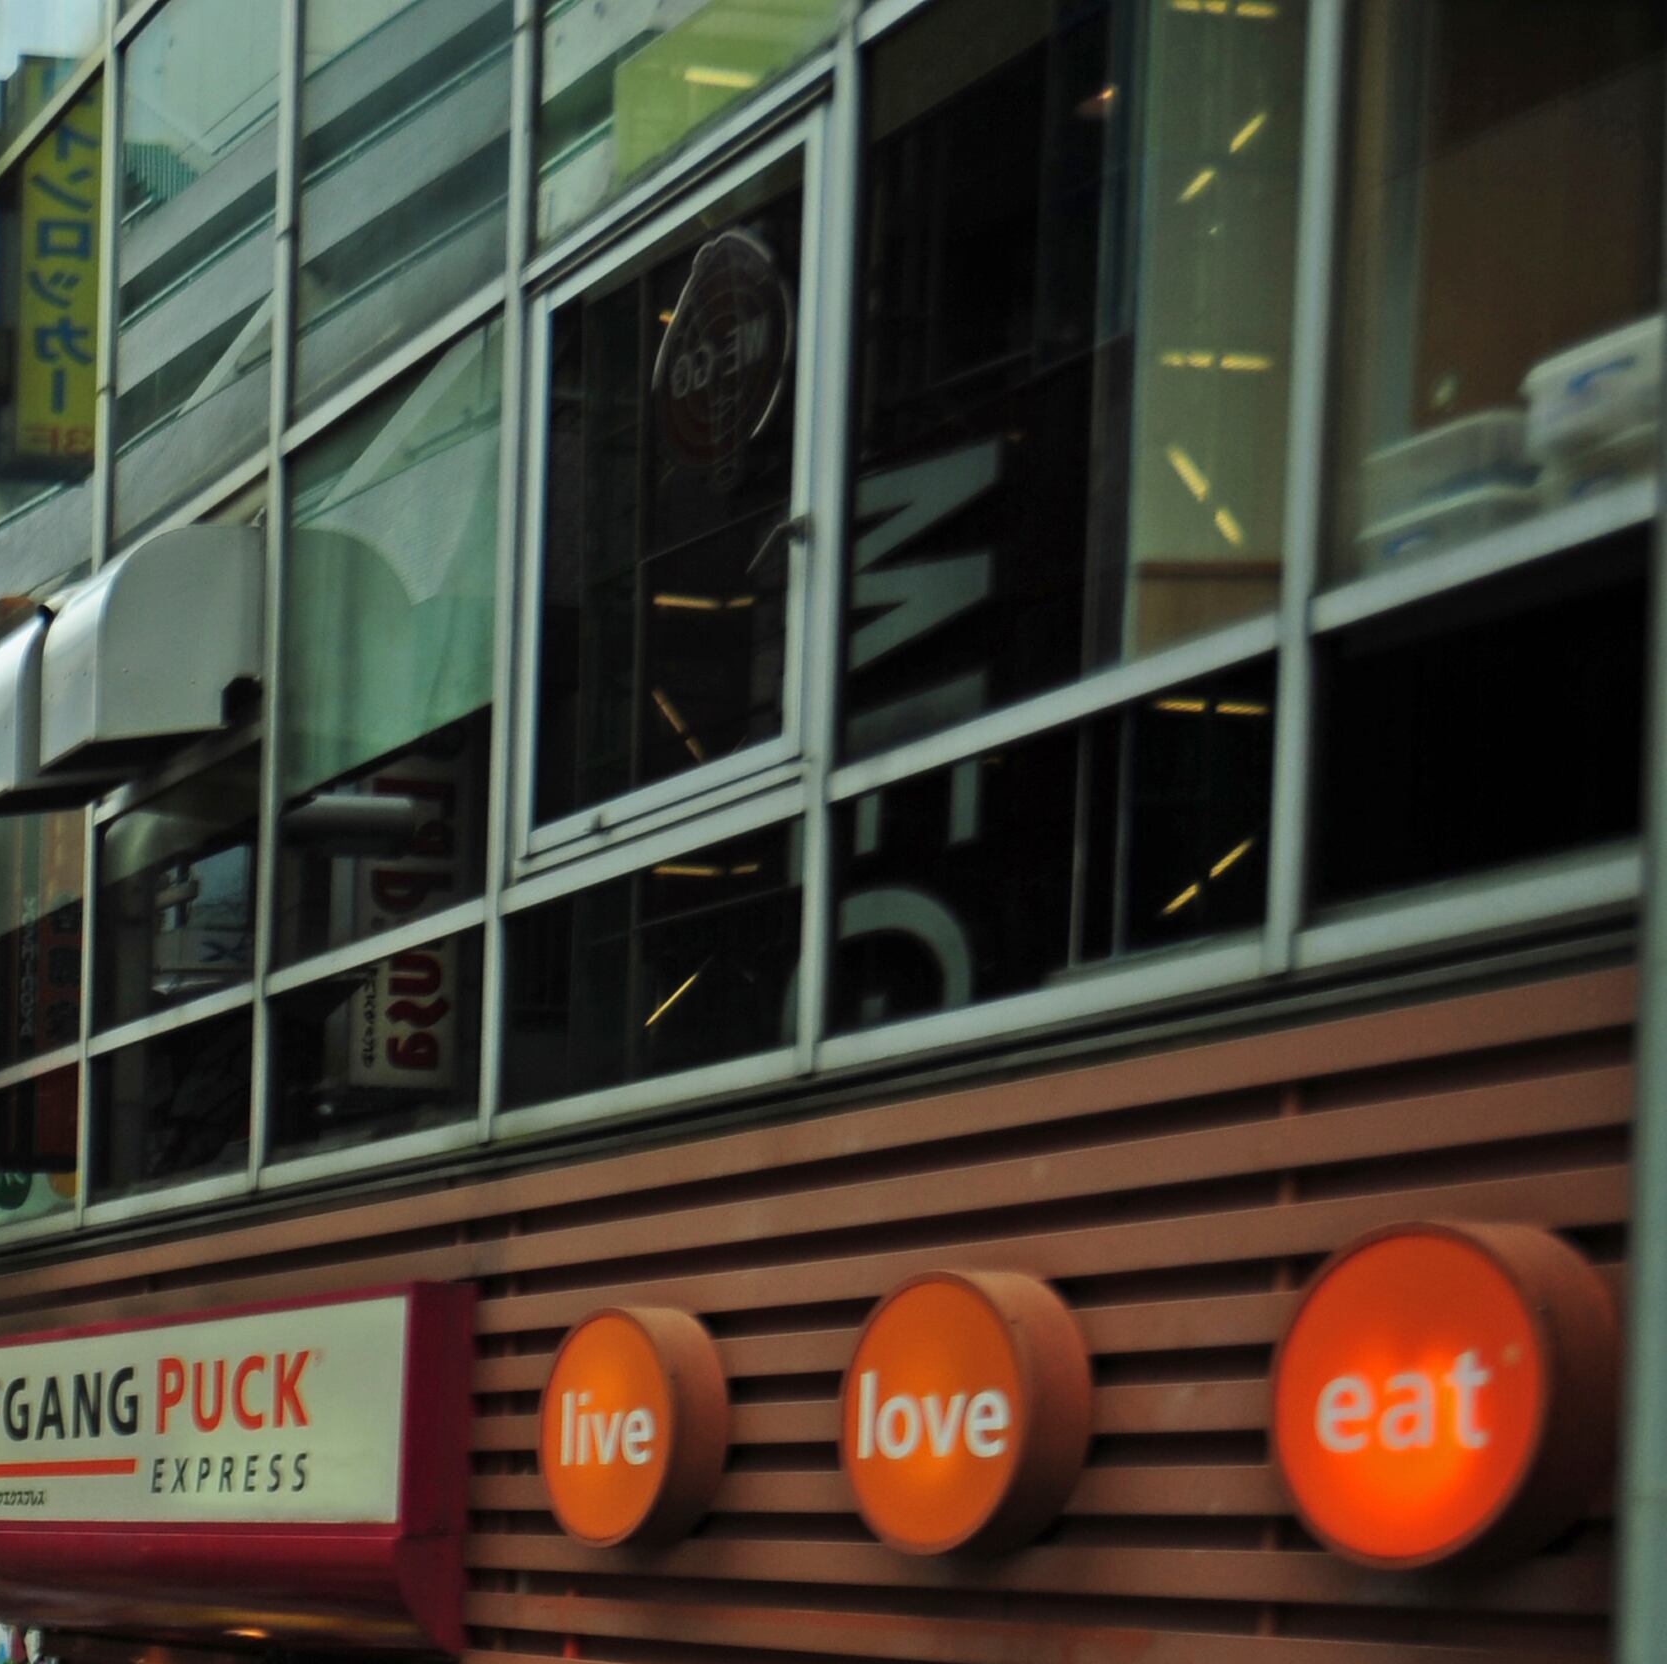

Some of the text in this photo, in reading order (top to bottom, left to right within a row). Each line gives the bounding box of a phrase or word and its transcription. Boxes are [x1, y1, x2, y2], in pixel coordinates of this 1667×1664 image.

[155, 1349, 313, 1435] PUCK
[558, 1390, 656, 1467] live
[856, 1370, 1012, 1460] love
[1312, 1349, 1493, 1454] eat
[150, 1452, 310, 1495] EXPRESS
